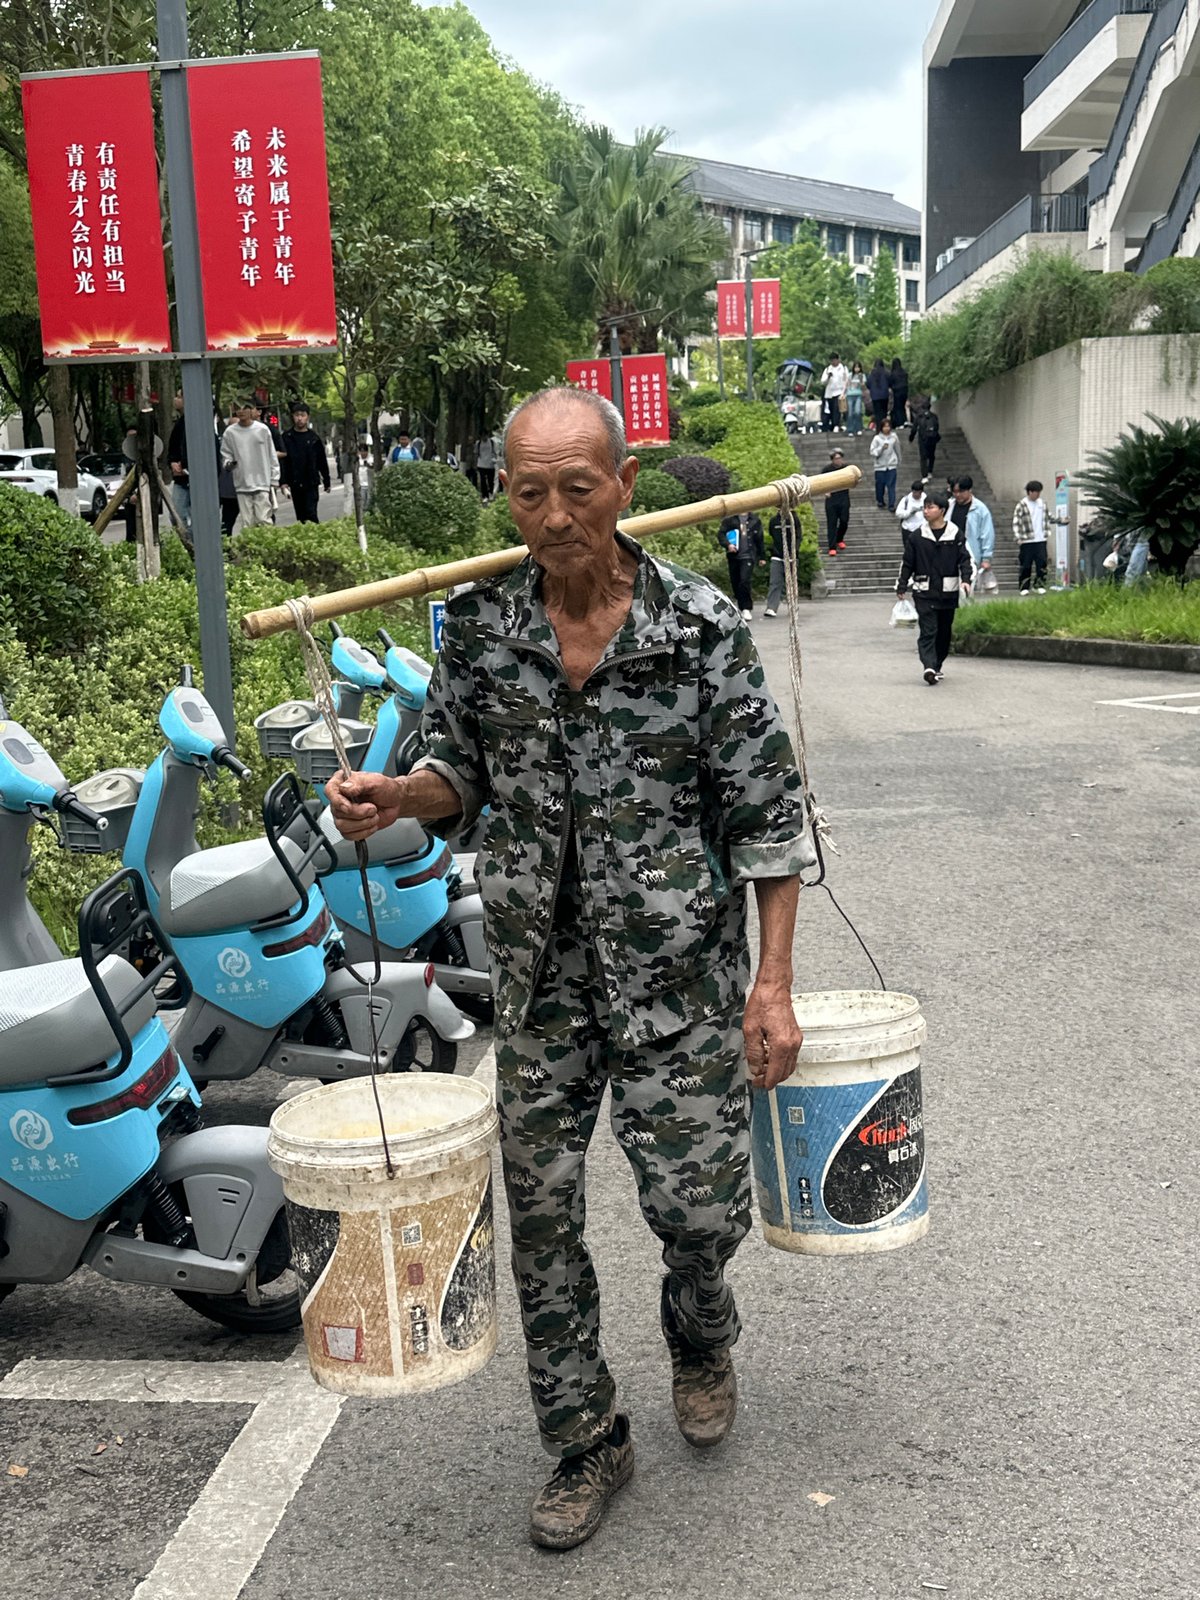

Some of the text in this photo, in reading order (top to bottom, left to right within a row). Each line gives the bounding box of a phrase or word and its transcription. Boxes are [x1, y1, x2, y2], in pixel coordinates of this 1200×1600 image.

[65, 144, 96, 294] 青春才会闪光
[95, 142, 126, 293] 有责任有担当
[230, 129, 262, 287] 希望寄予青年
[265, 127, 296, 286] 未来属于青年
